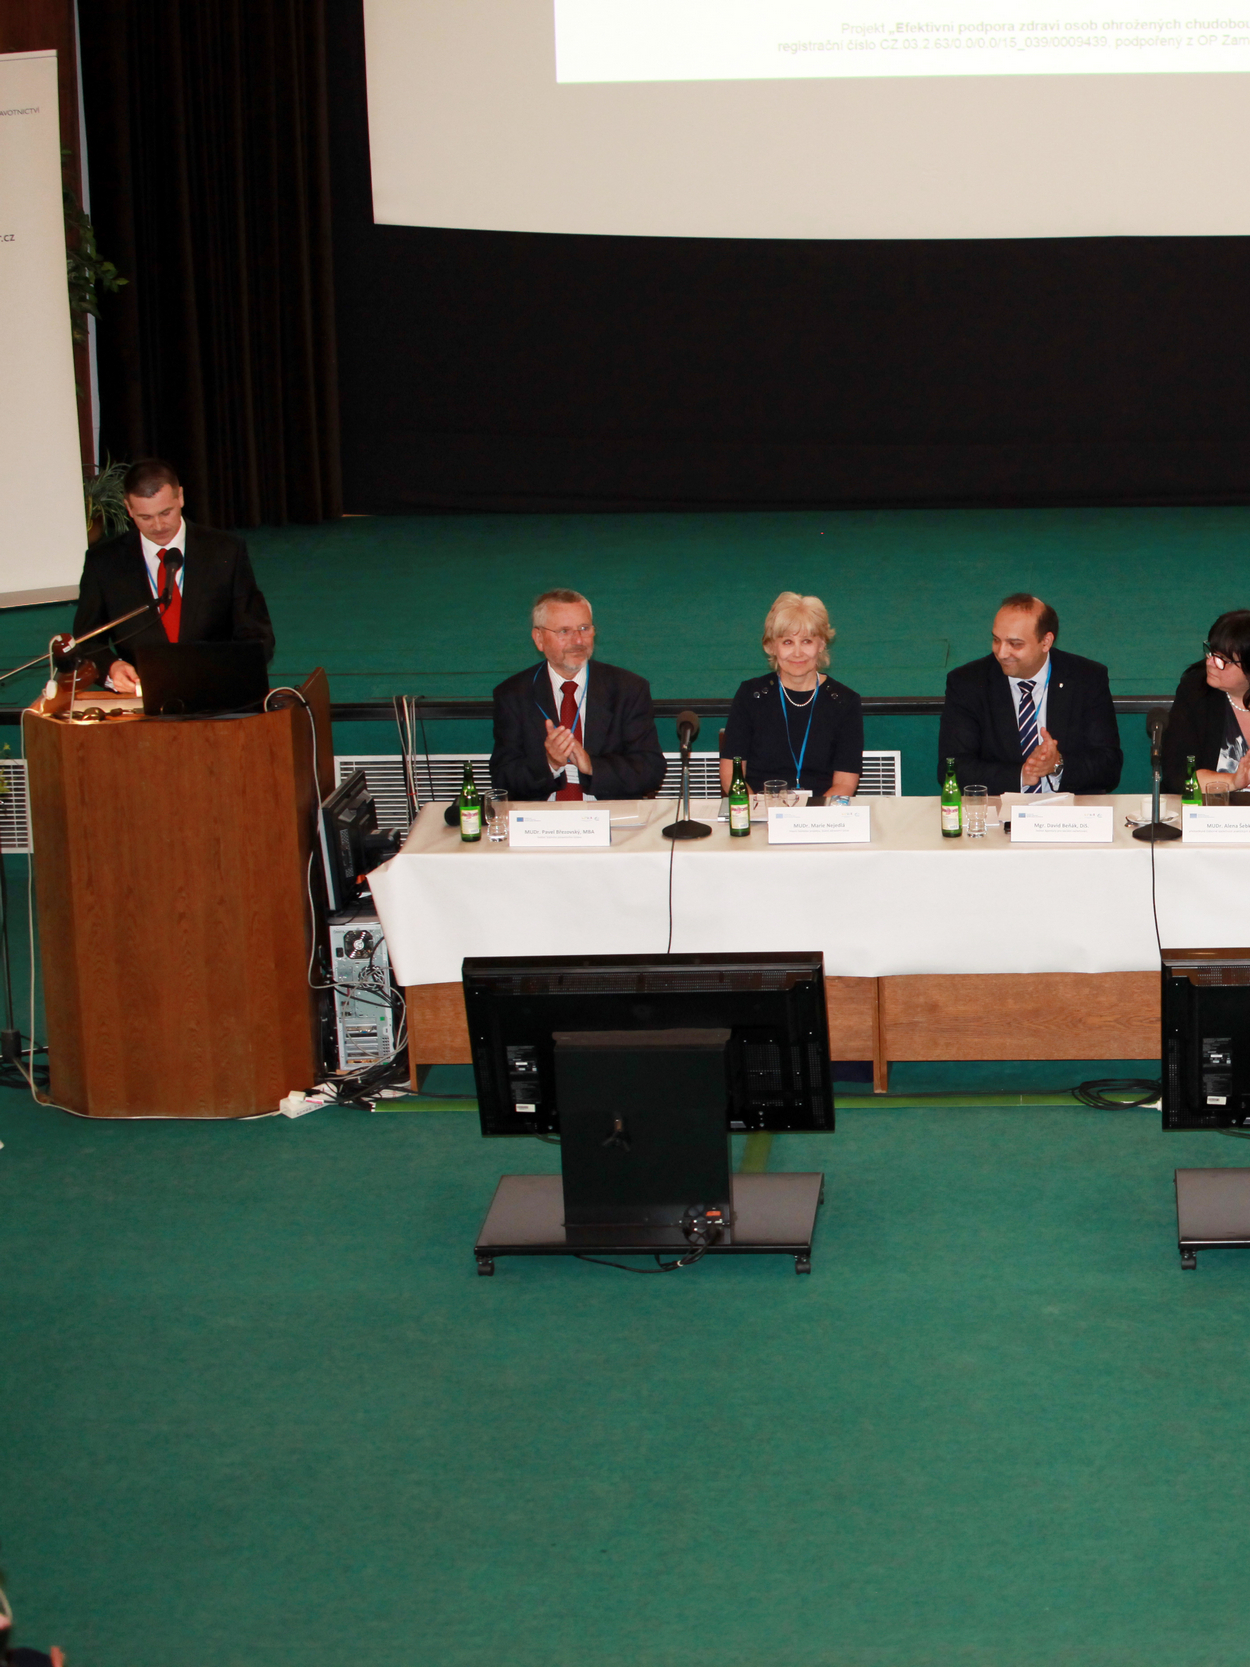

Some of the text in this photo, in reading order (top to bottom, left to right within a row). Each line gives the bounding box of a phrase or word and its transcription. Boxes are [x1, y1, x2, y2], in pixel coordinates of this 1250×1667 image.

[841, 22, 885, 36] Projekt
[957, 21, 1015, 34] podpora
[1063, 20, 1097, 31] osob
[1101, 18, 1181, 33] ohrožených
[777, 39, 844, 54] registrační
[1115, 35, 1182, 50] podpořený
[1185, 36, 1193, 46] z
[1197, 34, 1217, 46] OP
